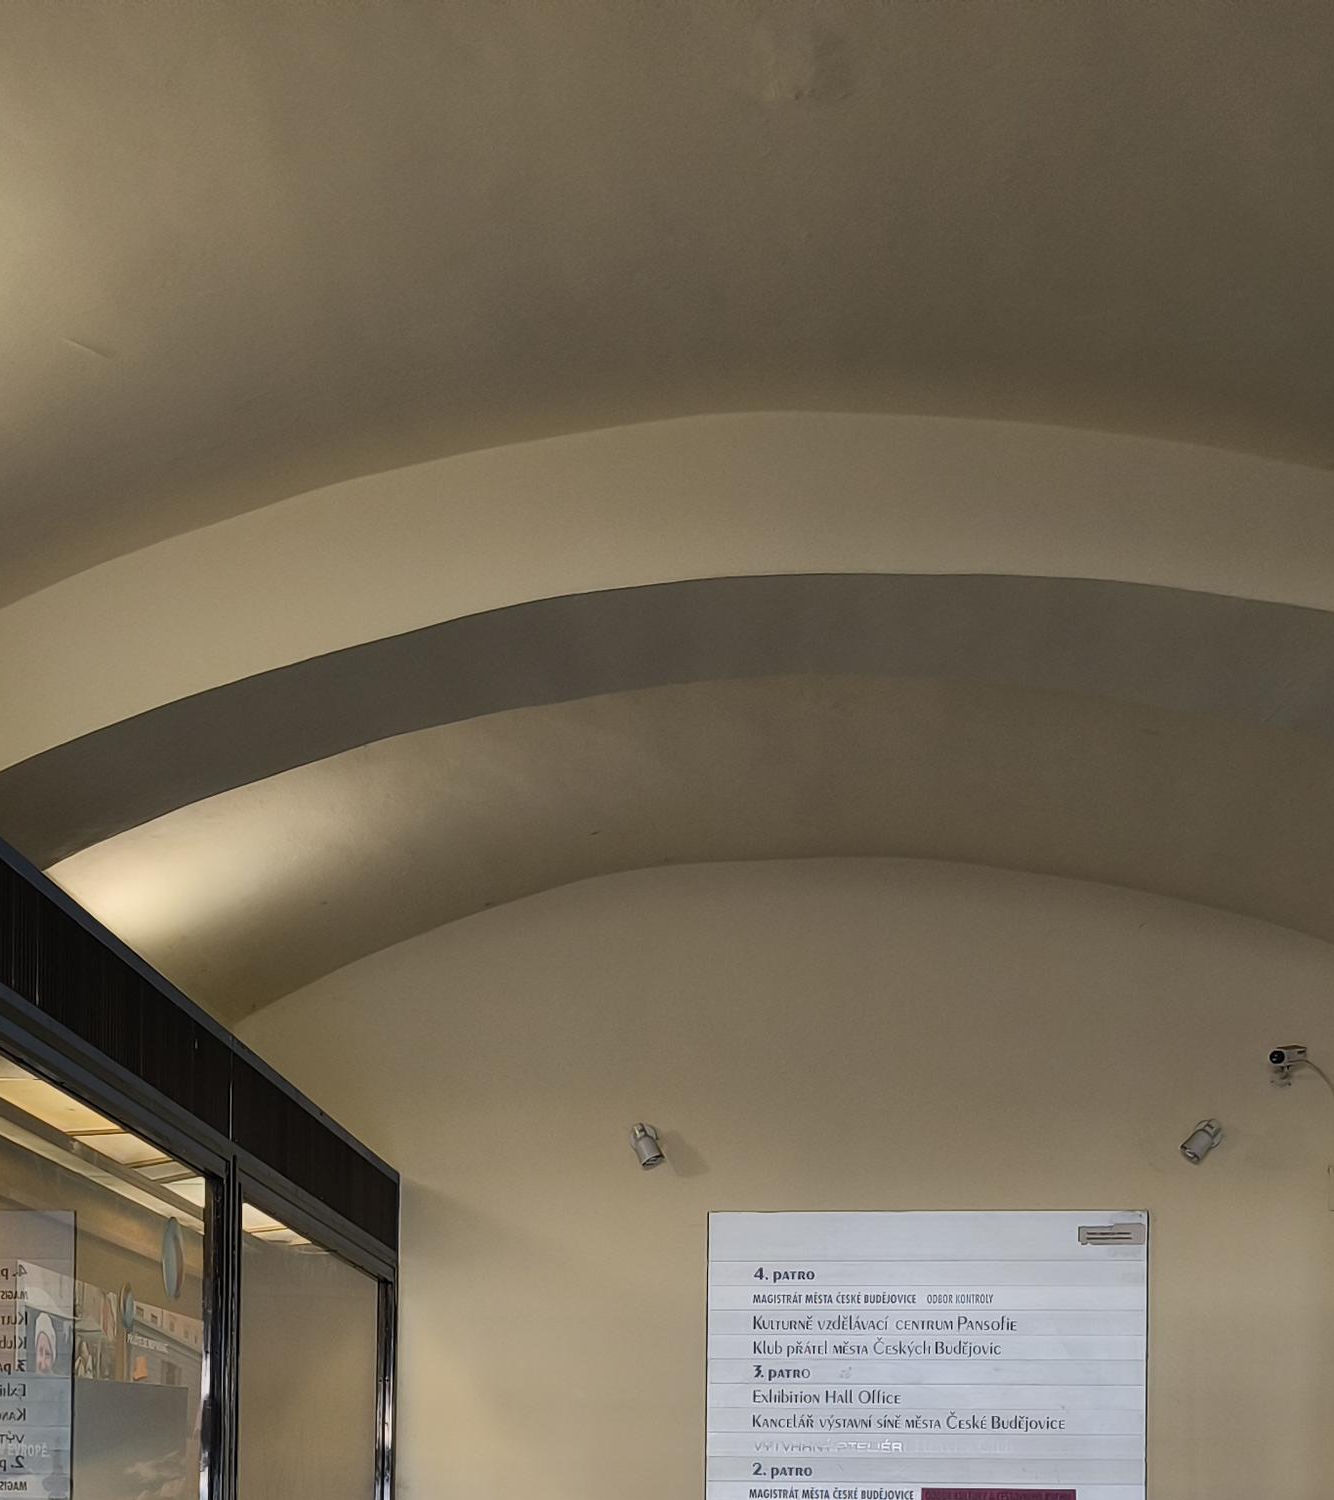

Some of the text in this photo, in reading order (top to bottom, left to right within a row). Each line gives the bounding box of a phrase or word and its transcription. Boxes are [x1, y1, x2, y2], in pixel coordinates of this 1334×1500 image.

[753, 1267, 815, 1283] 4. patro
[752, 1291, 994, 1304] MAGISTRÁT MĚSTA ČESKÉ BUDĚJOVICE ODBOR KONTROLY
[753, 1315, 1018, 1331] Kulturně vzdělávací centrum Pansofie
[753, 1337, 1002, 1358] Klub přátel města Českých Budějovic
[753, 1364, 810, 1381] 3. patro
[753, 1389, 902, 1405] Exhibition Hall Office
[752, 1411, 1066, 1432] Kancelář výstavní síně města České Budějovice
[752, 1462, 813, 1479] 2. patro
[749, 1486, 799, 1500] MAGISTRÁT
[801, 1486, 830, 1500] MĚSTA
[833, 1487, 858, 1500] ČESKÉ
[860, 1487, 915, 1500] BUDĚJOVICE
